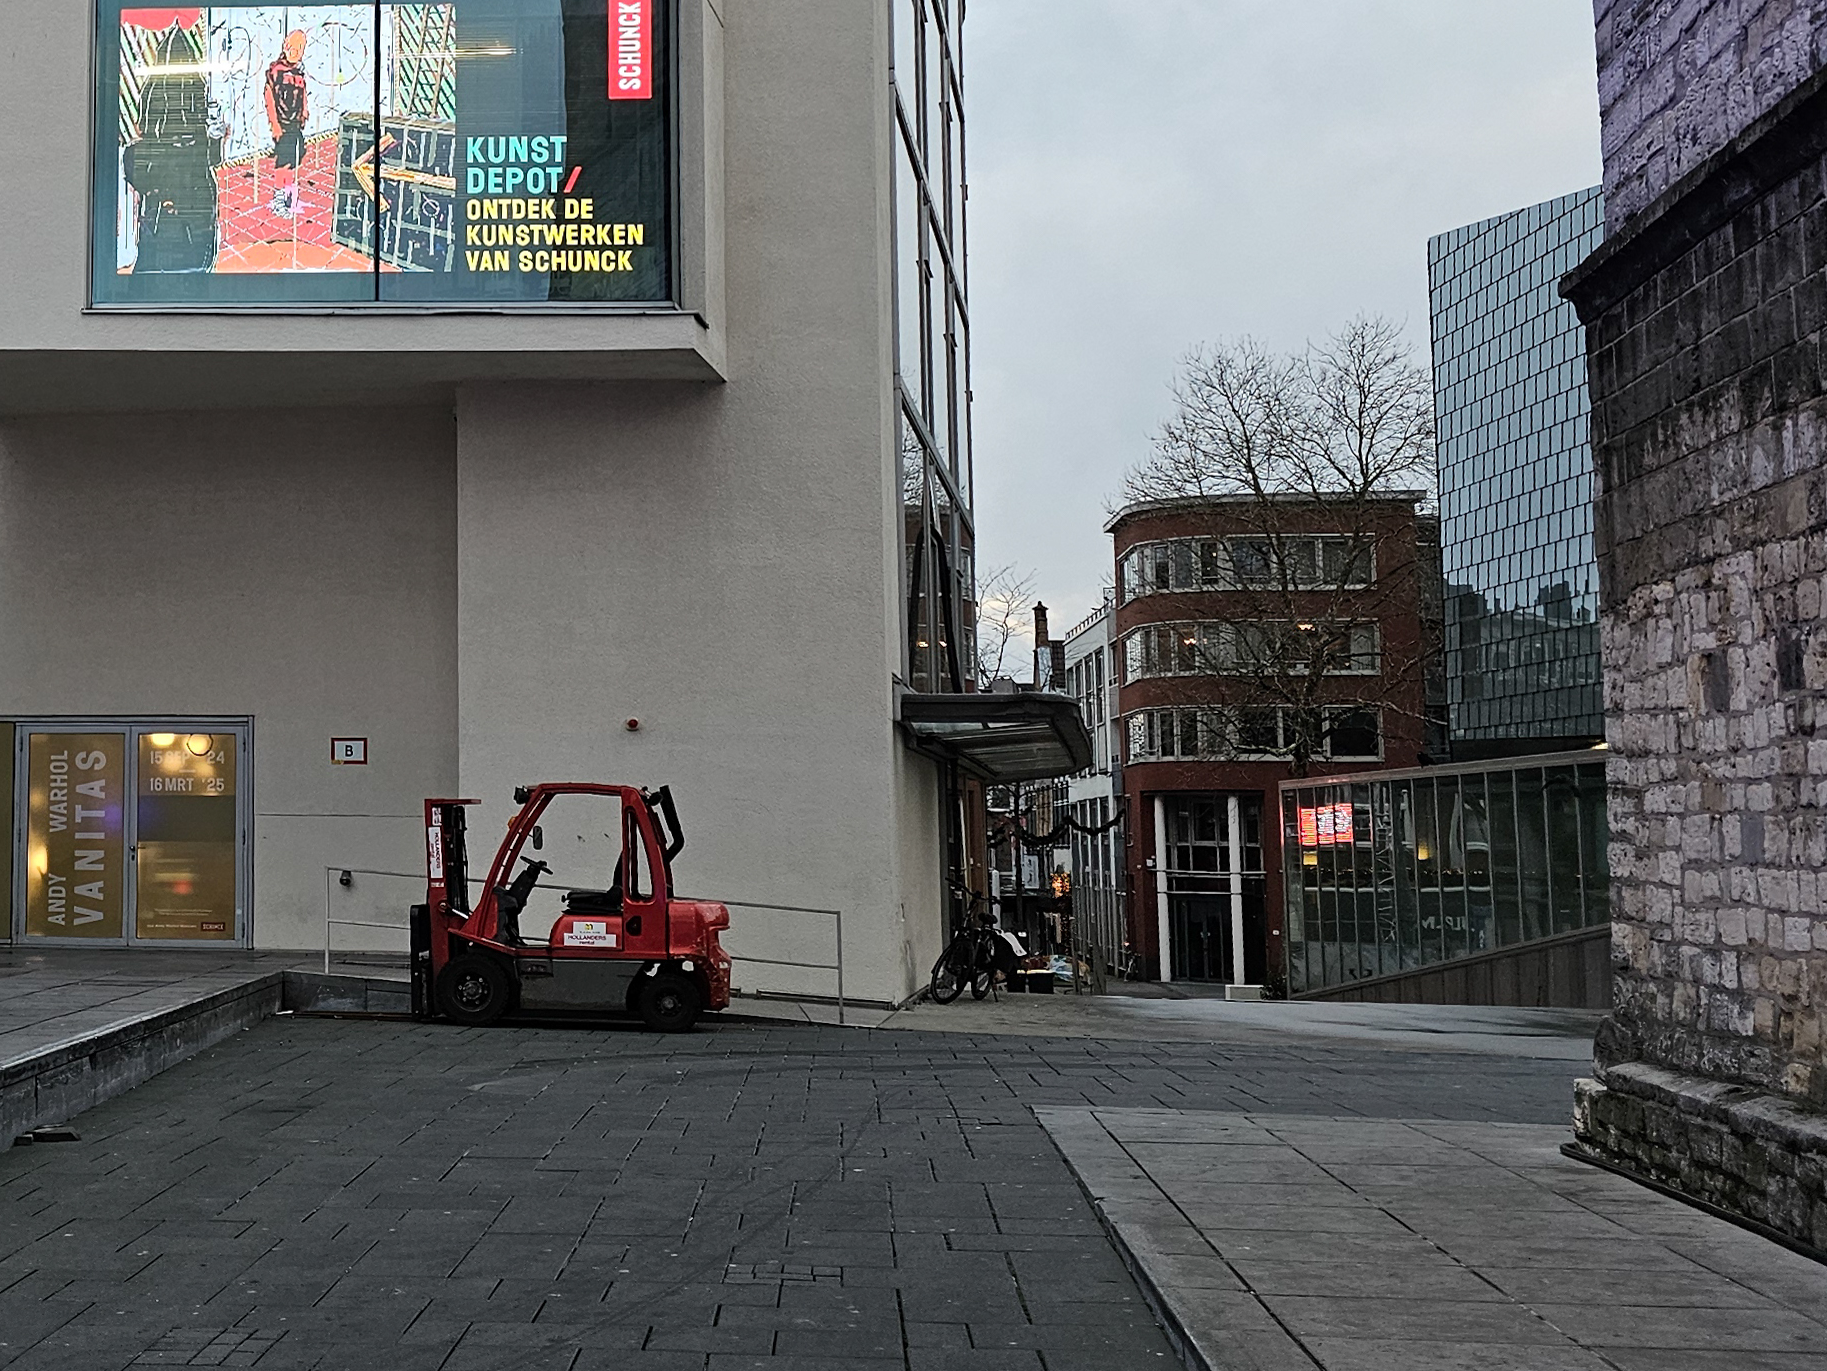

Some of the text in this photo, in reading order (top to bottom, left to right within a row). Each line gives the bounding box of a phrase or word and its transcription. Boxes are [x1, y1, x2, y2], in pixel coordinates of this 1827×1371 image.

[618, 1, 642, 91] SCHUNCK
[466, 135, 568, 164] KUNST
[465, 197, 594, 220] ONTDEK DE
[465, 223, 645, 247] KUNSTWERKEN
[464, 250, 634, 273] VAN SCHUNCK
[149, 750, 163, 765] 15
[344, 744, 354, 758] B
[149, 777, 163, 792] 16
[165, 777, 194, 792] MRT
[47, 750, 69, 926] ANDY WARHOL
[73, 750, 107, 926] VANITAS
